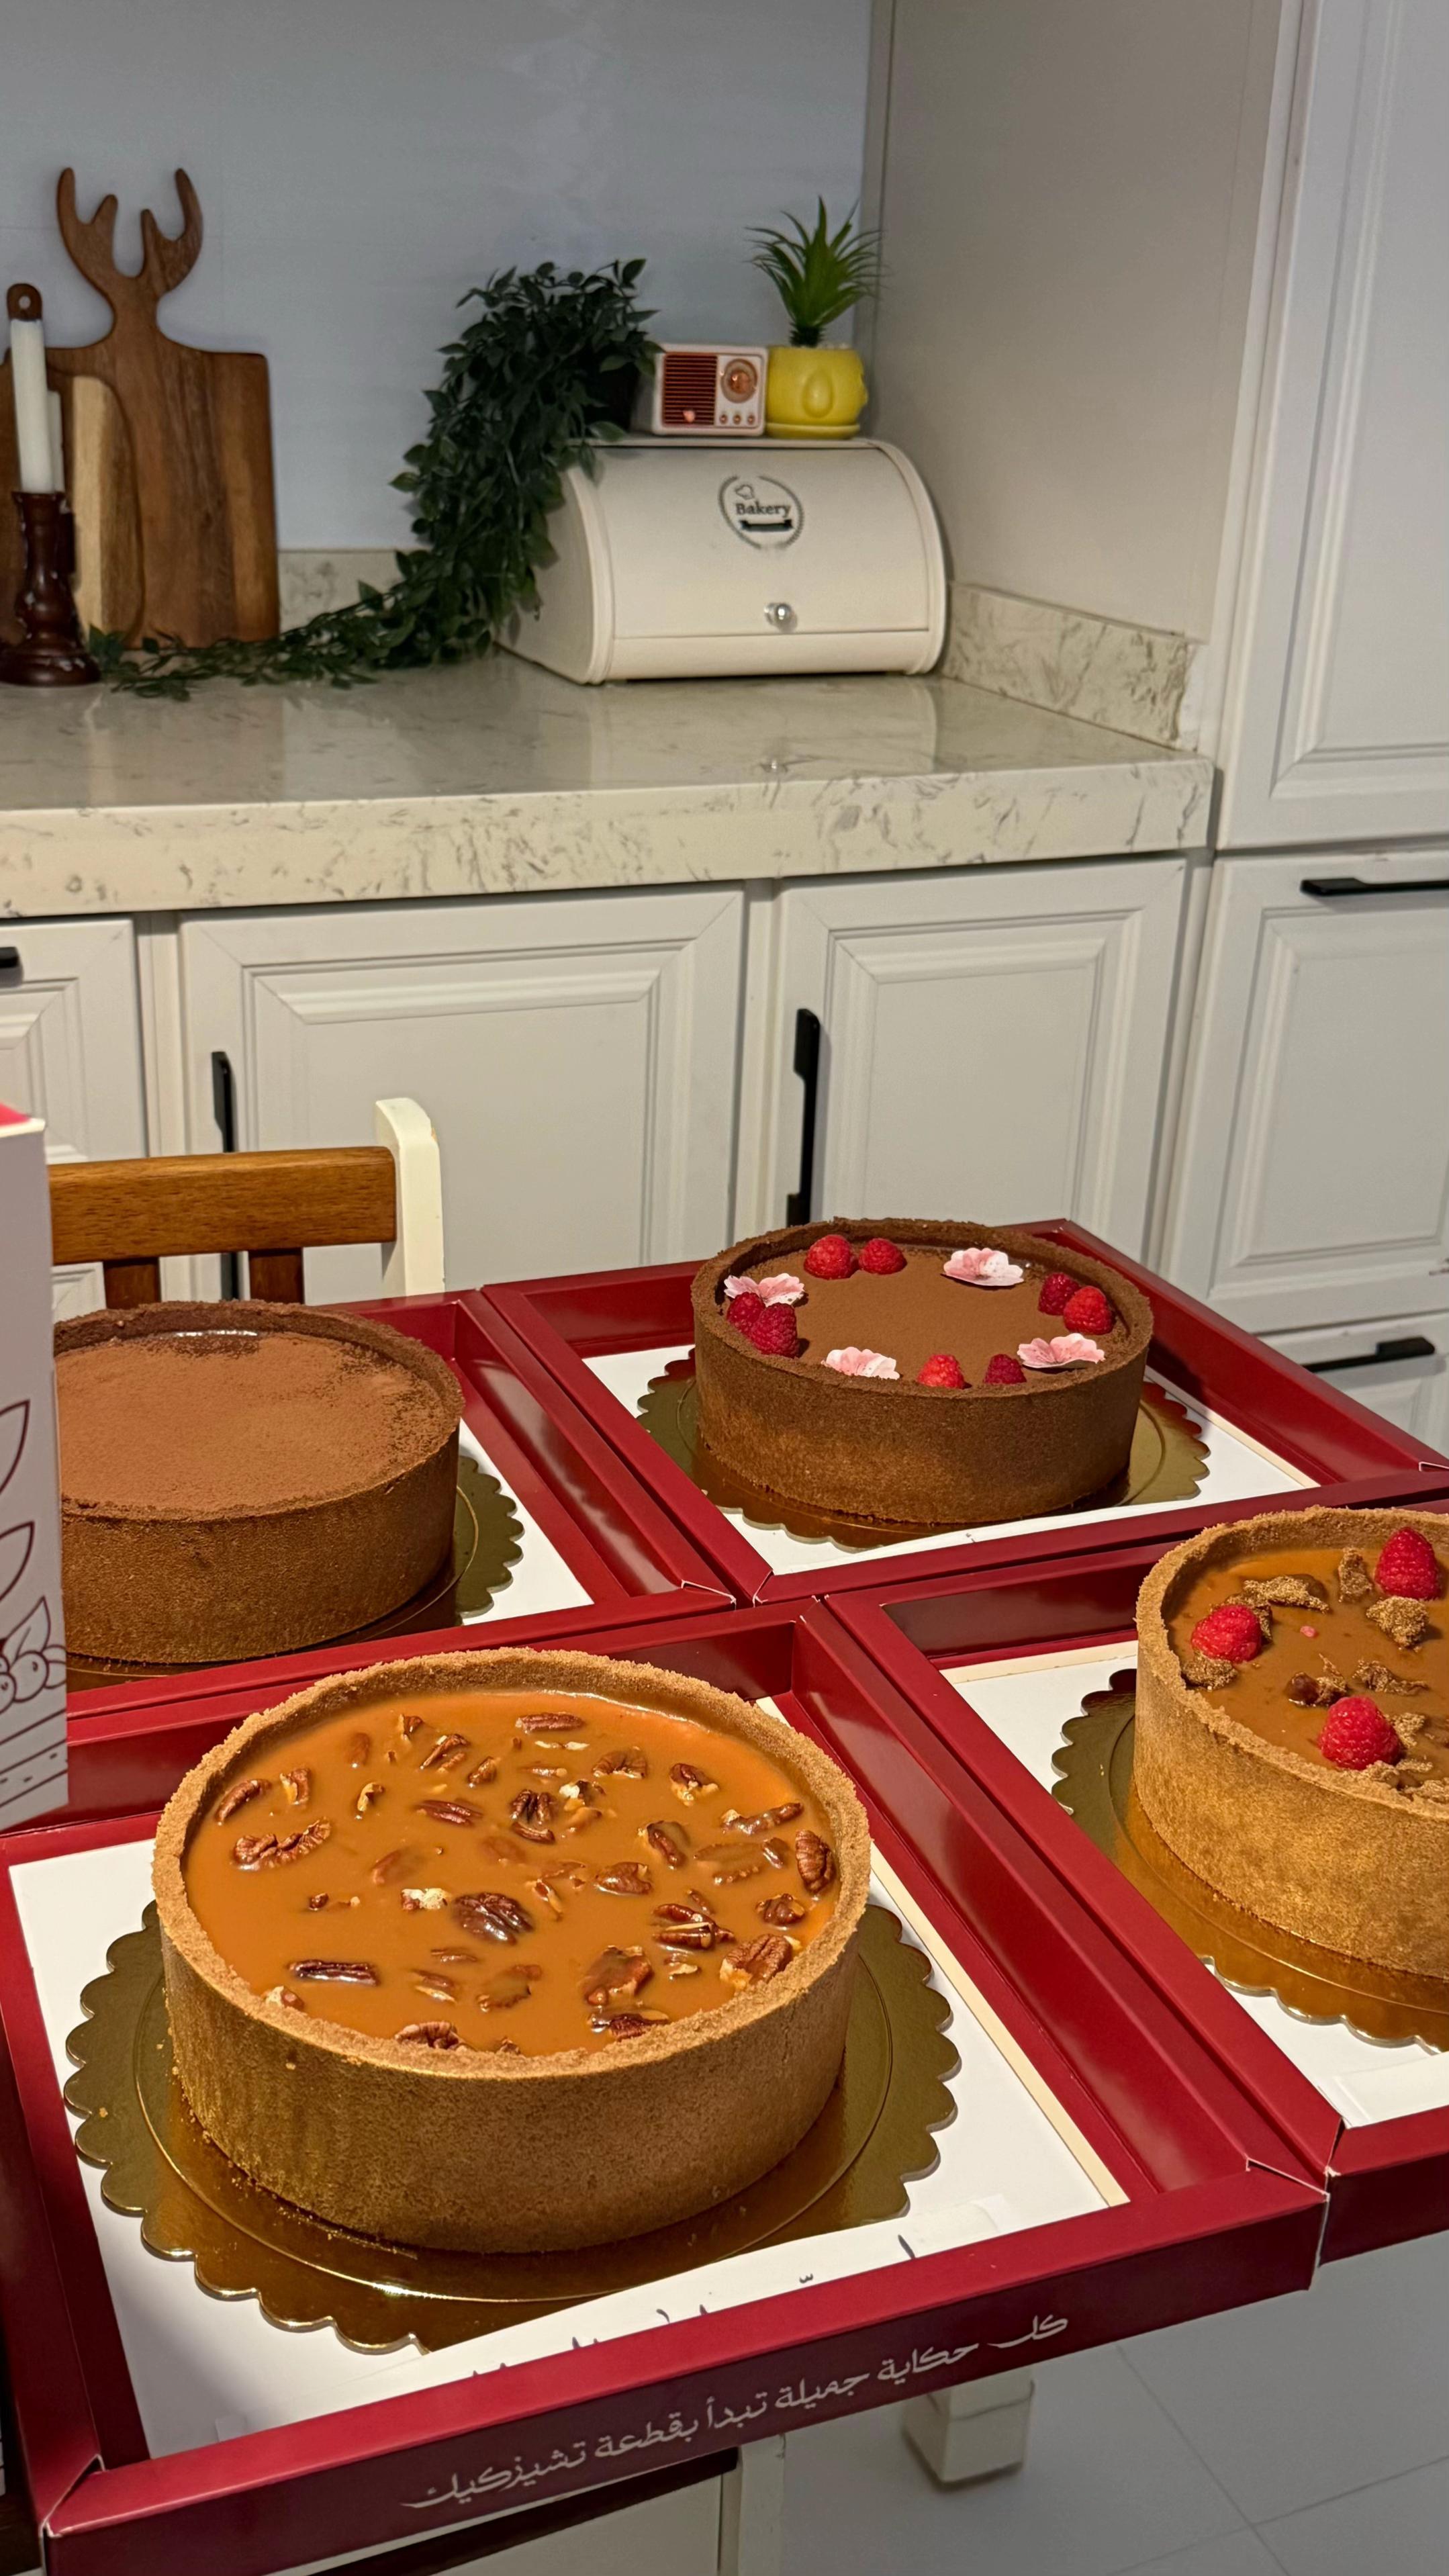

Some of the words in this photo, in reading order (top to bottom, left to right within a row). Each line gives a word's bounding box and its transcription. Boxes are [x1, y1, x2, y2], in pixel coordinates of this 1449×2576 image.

[735, 500, 792, 518] Bakery
[986, 2314, 1069, 2349] كل
[877, 2342, 980, 2385] حكاية
[774, 2373, 870, 2409] جميلة
[706, 2395, 768, 2430] تبدأ
[594, 2411, 700, 2458] بقطعة
[400, 2440, 587, 2509] تشيزكيك
